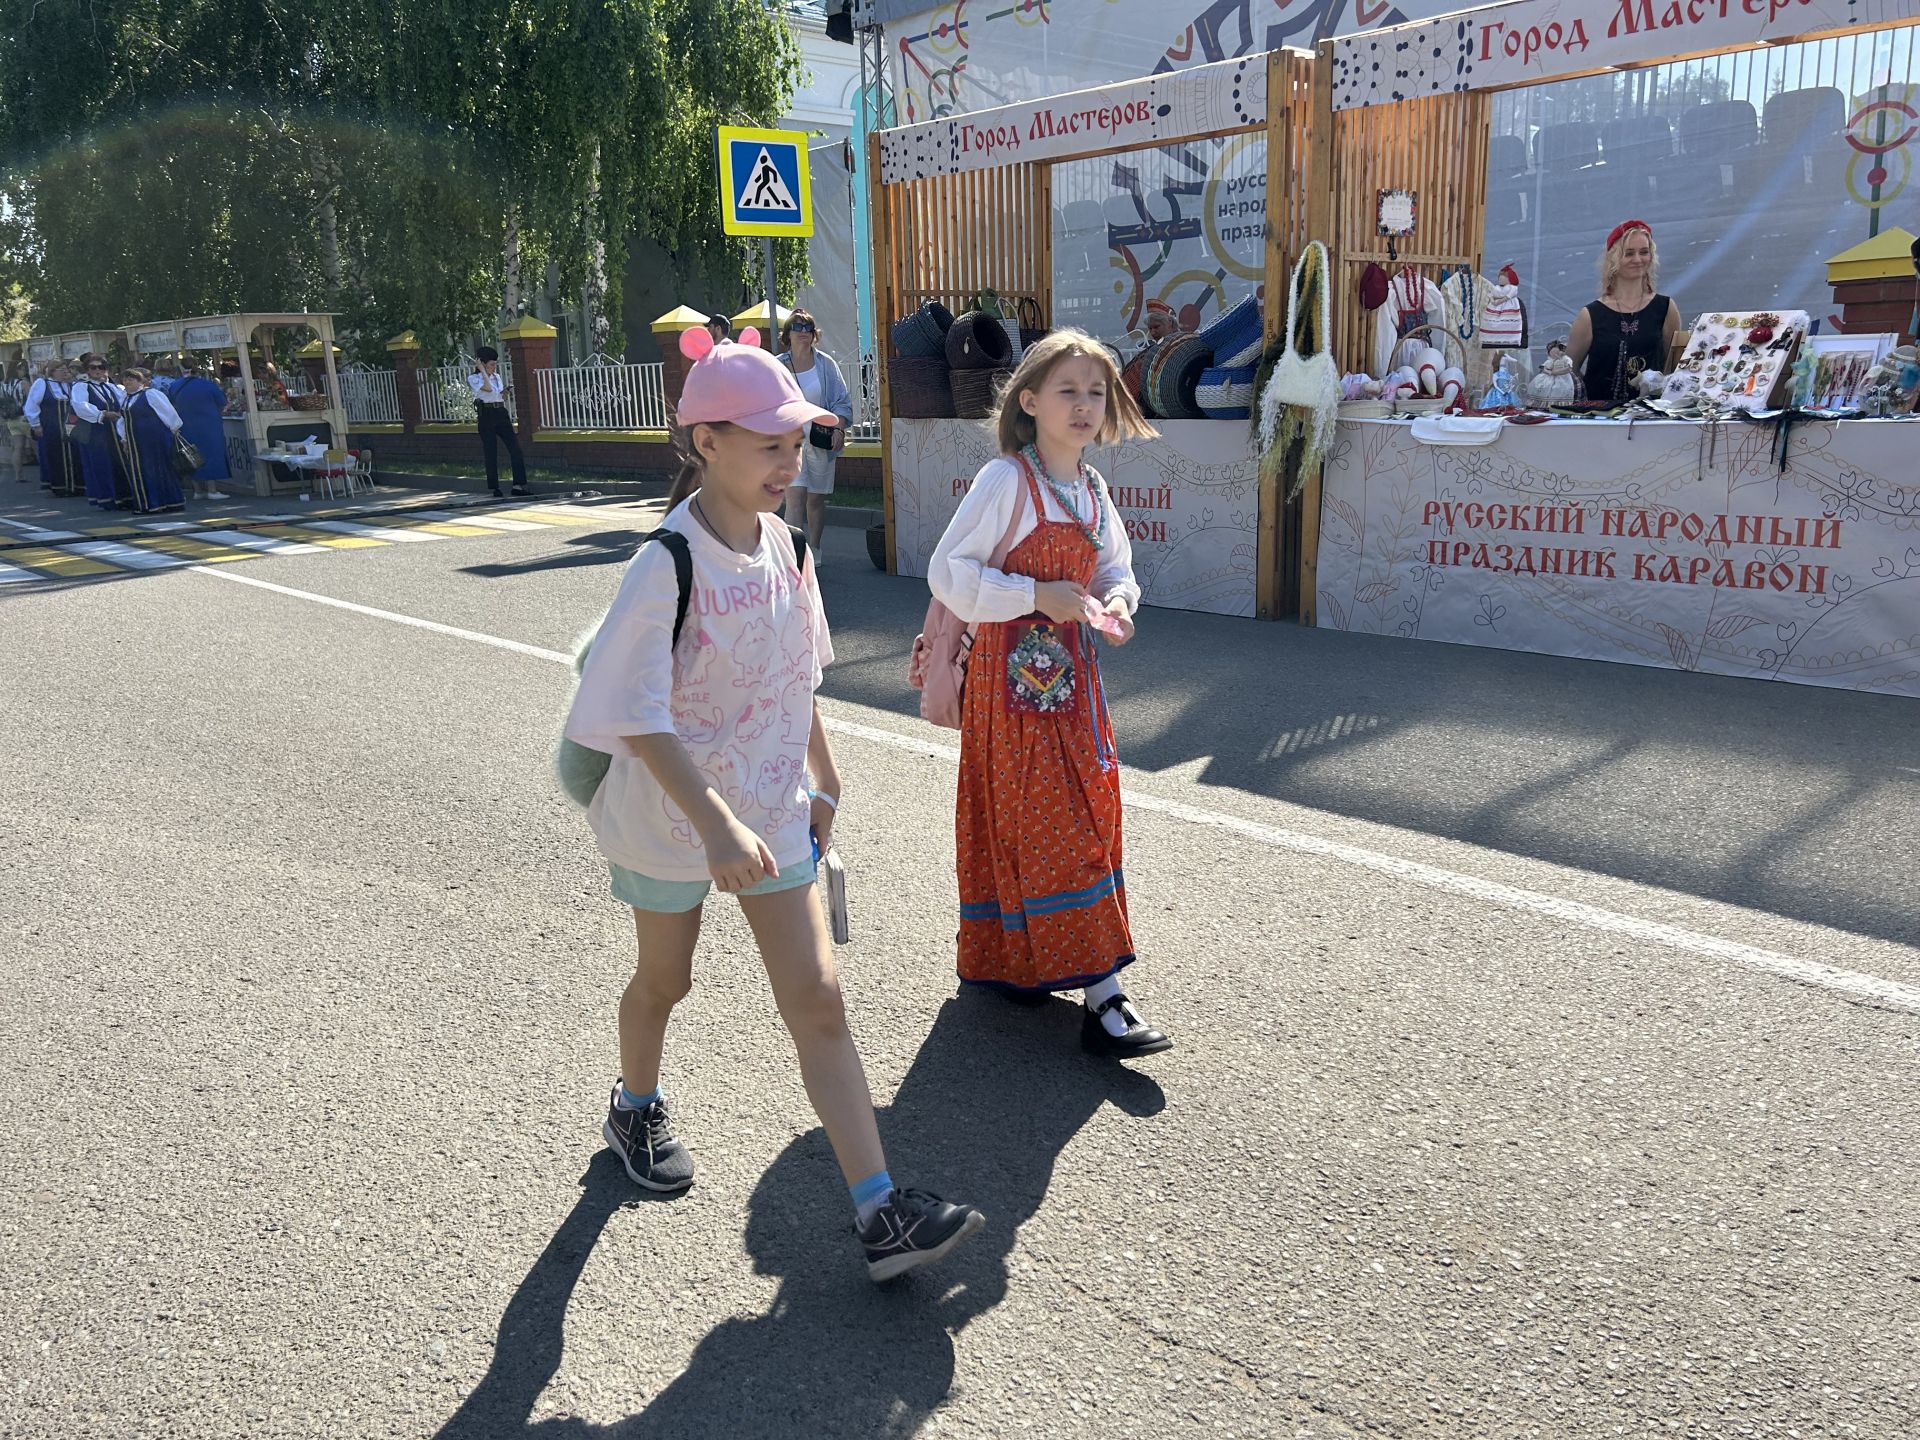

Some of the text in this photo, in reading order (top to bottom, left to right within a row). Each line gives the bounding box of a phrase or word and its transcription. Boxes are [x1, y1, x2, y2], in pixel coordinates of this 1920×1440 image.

[1477, 0, 1810, 65] Город Мастер
[961, 100, 1150, 156] Город Мастеров
[1421, 501, 1844, 549] РУССКИЙ НАРОДНЫЙ
[1426, 540, 1829, 594] ПРАЗДНИК КАРАВОН
